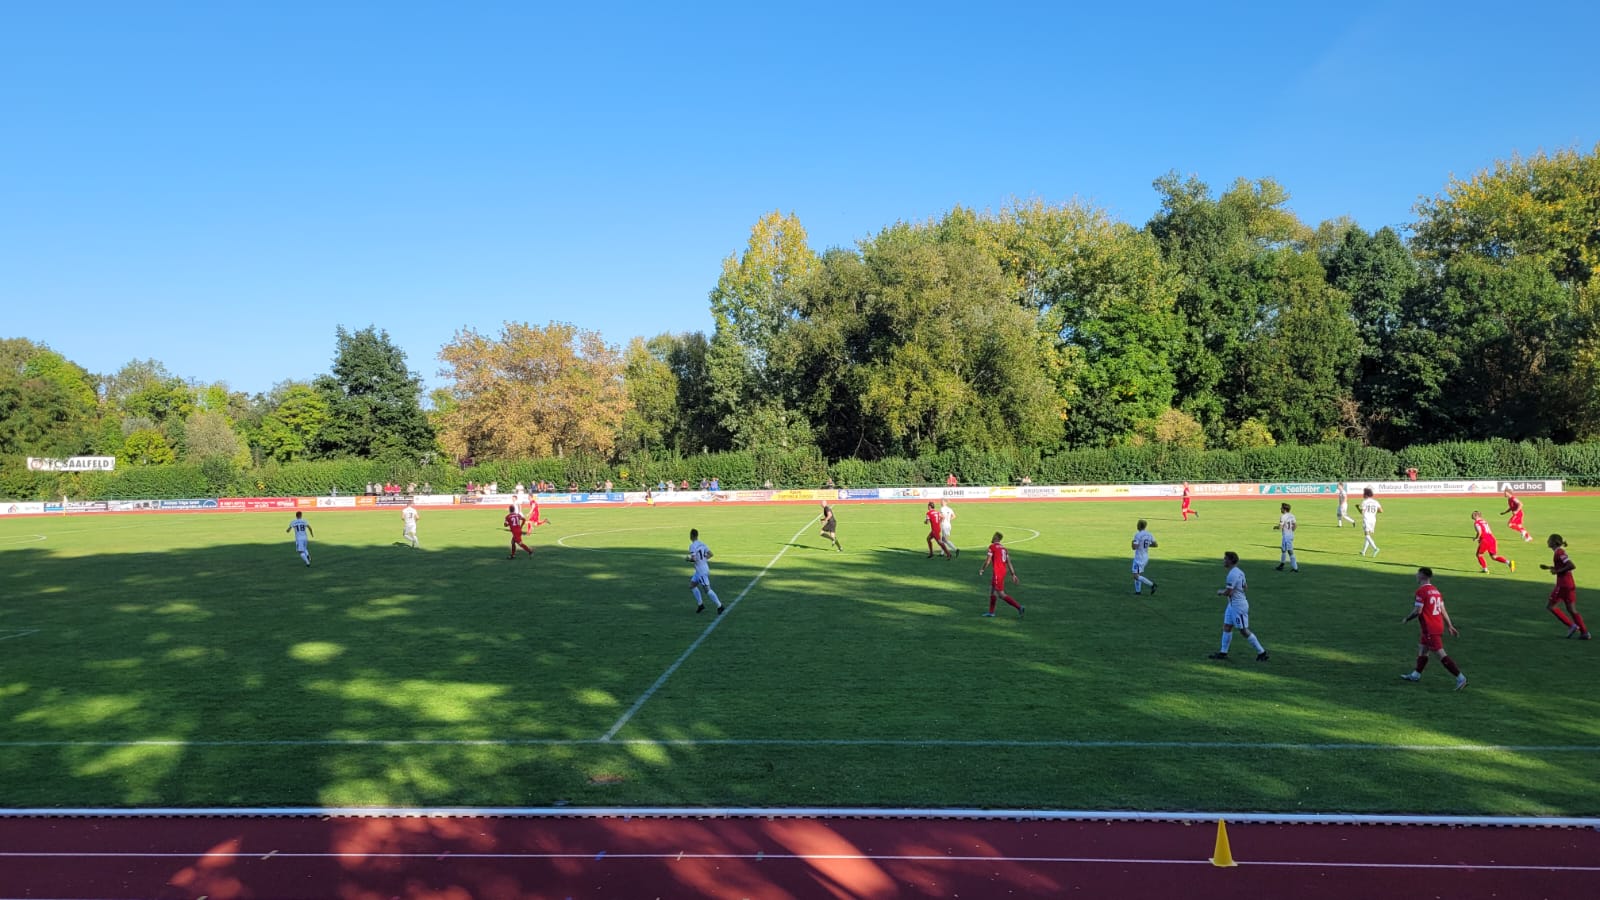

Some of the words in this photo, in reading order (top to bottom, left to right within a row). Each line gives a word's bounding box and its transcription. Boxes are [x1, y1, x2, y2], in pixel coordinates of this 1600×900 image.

[48, 460, 60, 468] FC
[63, 459, 109, 468] SAALFELD
[296, 524, 305, 532] 18
